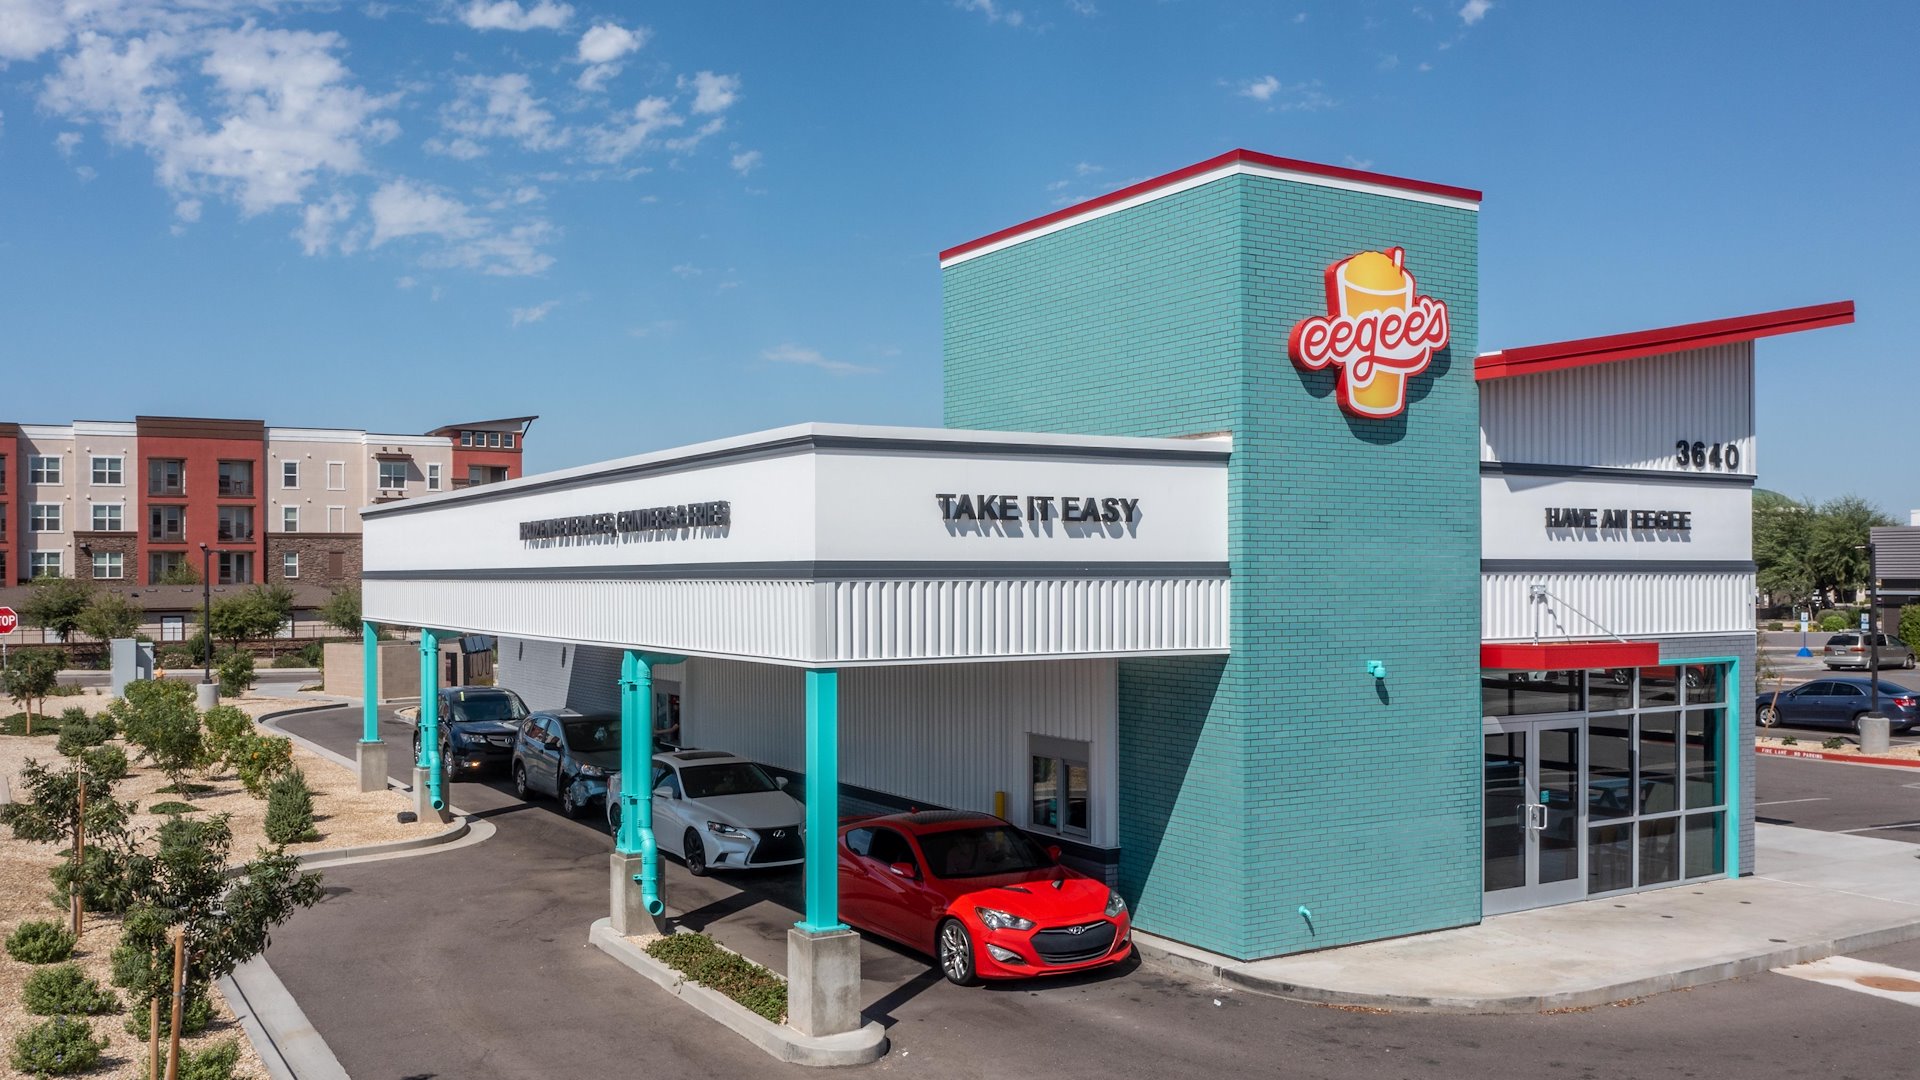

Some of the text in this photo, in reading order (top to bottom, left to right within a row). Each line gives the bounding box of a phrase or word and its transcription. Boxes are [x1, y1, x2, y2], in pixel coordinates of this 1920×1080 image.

[1303, 302, 1444, 383] eegee's
[1676, 440, 1740, 470] 3640
[617, 506, 676, 533] GRINDERS
[687, 500, 730, 528] FRIES
[935, 493, 1140, 523] TAKE IT EASY
[1545, 507, 1692, 530] HAVE AN EEGEE
